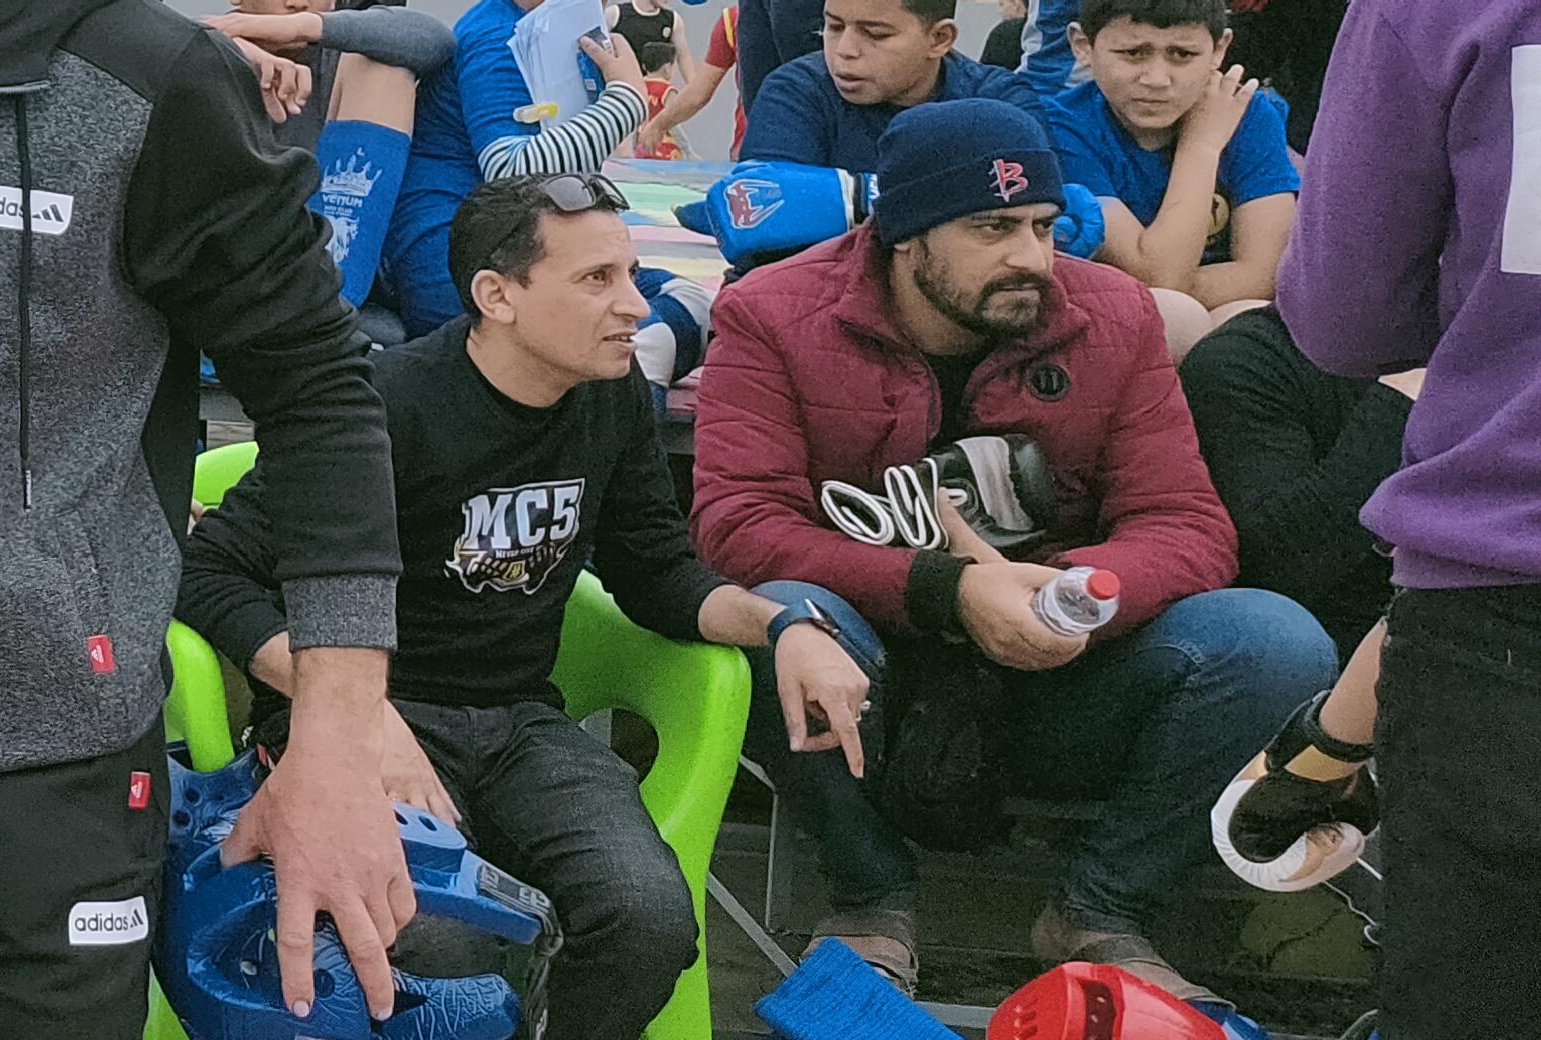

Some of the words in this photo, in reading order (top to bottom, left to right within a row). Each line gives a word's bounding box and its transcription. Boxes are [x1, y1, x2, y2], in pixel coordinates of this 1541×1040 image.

[322, 193, 363, 208] VENUM
[463, 485, 581, 549] MC5
[74, 912, 129, 933] adidas
